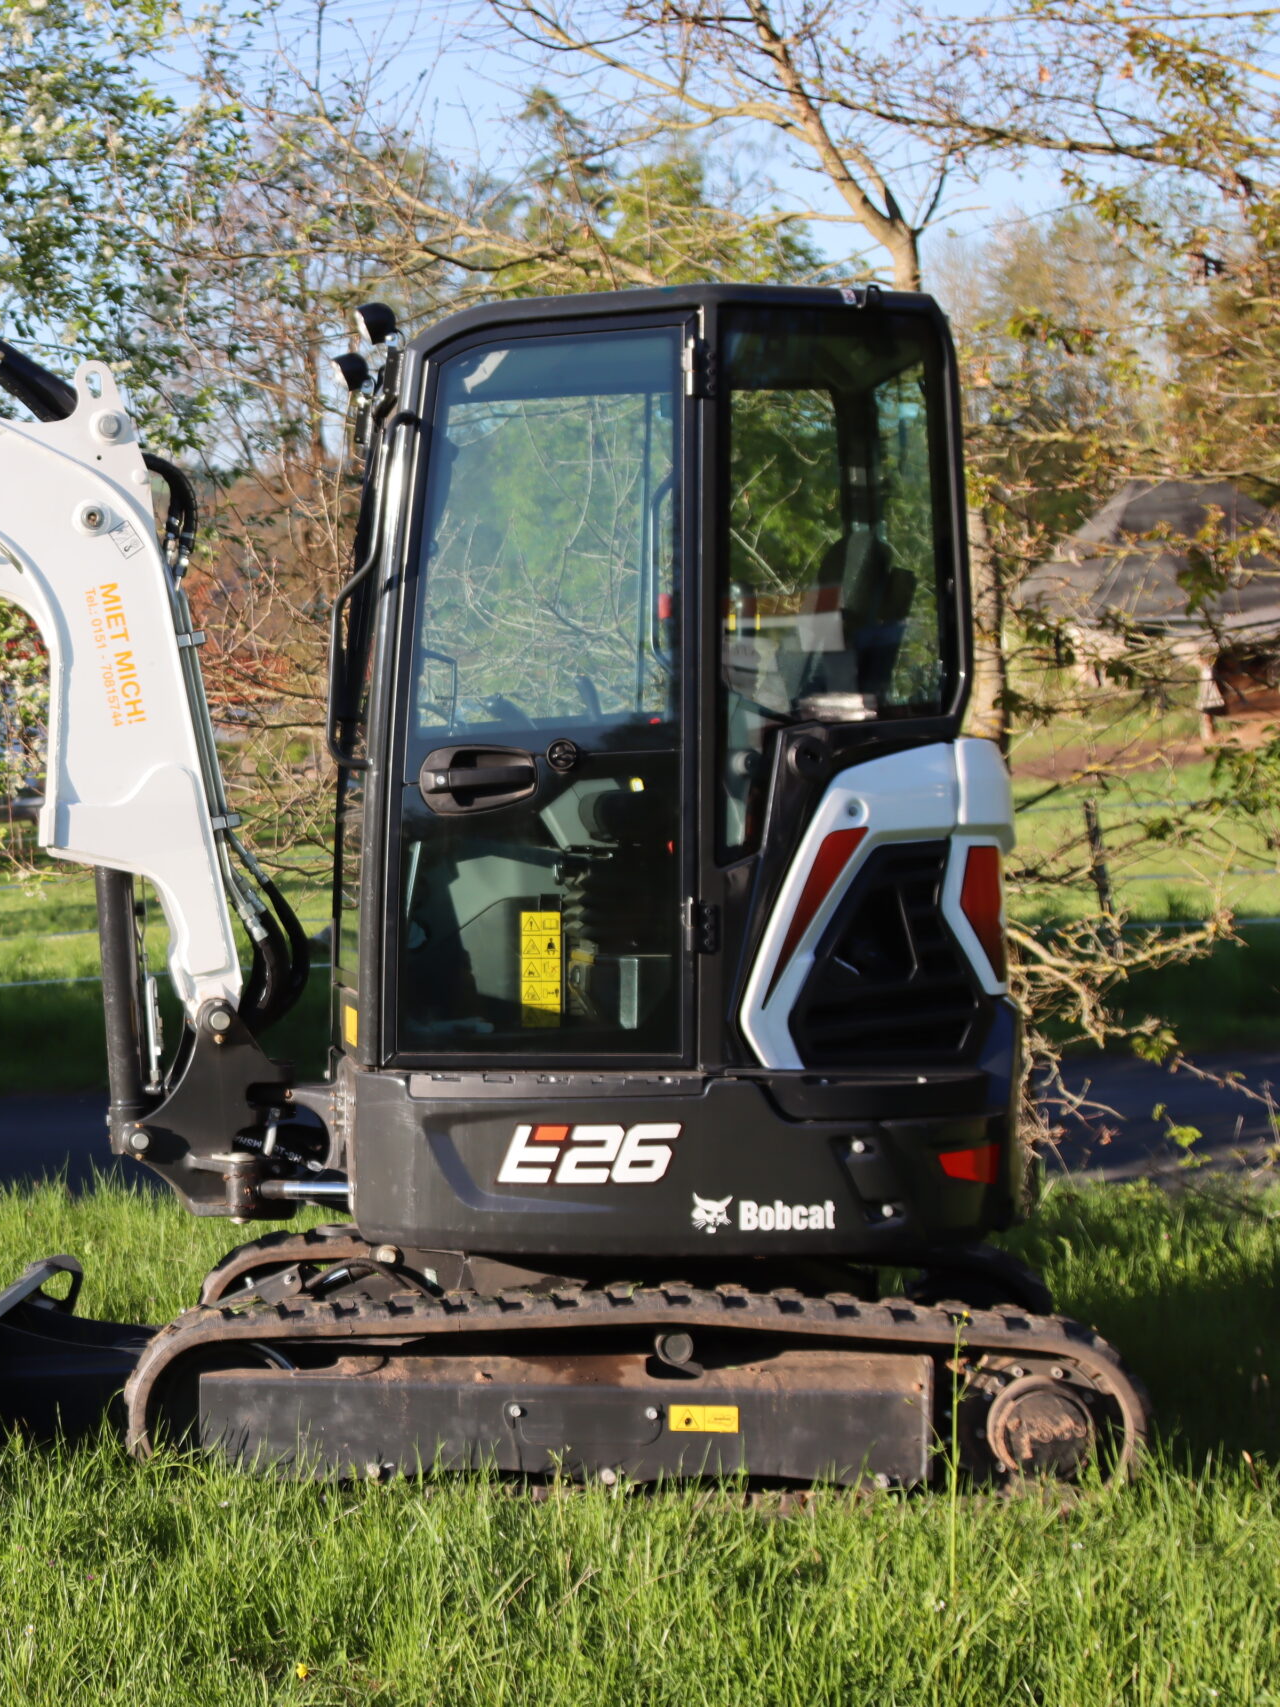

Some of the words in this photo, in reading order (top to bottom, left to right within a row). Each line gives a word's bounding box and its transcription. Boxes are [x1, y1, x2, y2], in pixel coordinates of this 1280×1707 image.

[99, 582, 130, 642] MIET
[91, 618, 107, 649] 0151
[100, 664, 124, 727] 70815744
[113, 650, 147, 724] MICH!
[497, 1124, 681, 1183] E26
[739, 1200, 836, 1231] Bobcat
